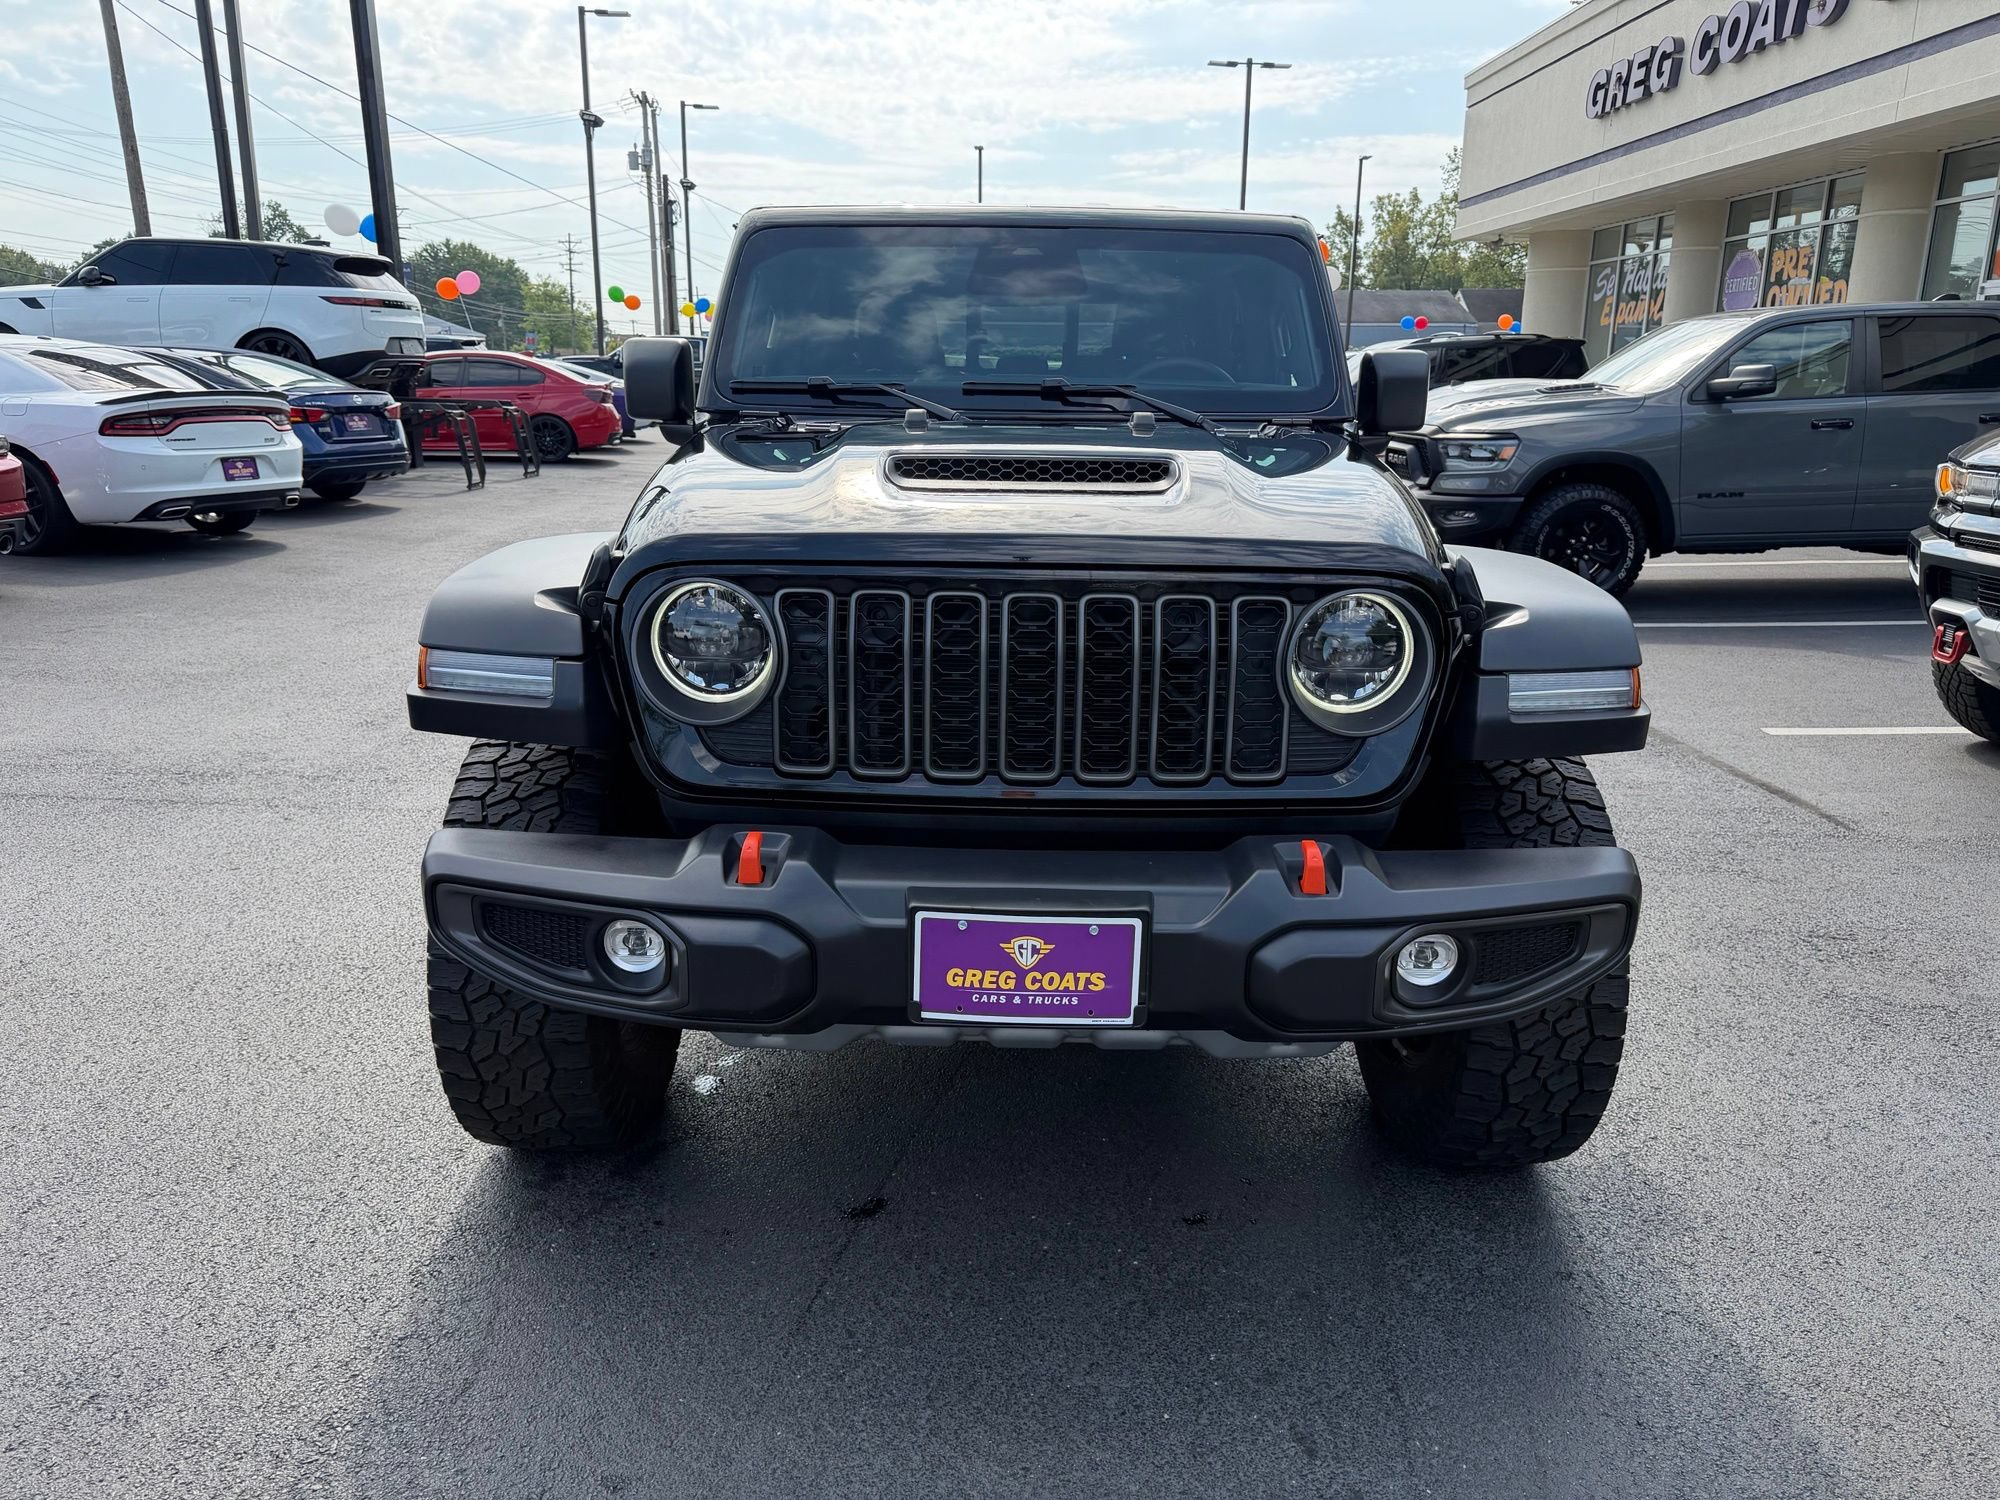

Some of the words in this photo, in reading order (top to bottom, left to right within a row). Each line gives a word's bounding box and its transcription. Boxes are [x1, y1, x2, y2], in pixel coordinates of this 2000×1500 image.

[1586, 36, 1685, 119] GREG
[1593, 266, 1616, 302] Se
[1724, 276, 1760, 294] CERTIFIED
[1697, 491, 1745, 500] RAM
[1014, 938, 1041, 967] GC
[946, 967, 1017, 990] GREG
[1025, 971, 1107, 991] COATS
[972, 993, 1007, 1004] CARS
[1012, 995, 1022, 1004] &
[1028, 995, 1079, 1005] TRUCKS
